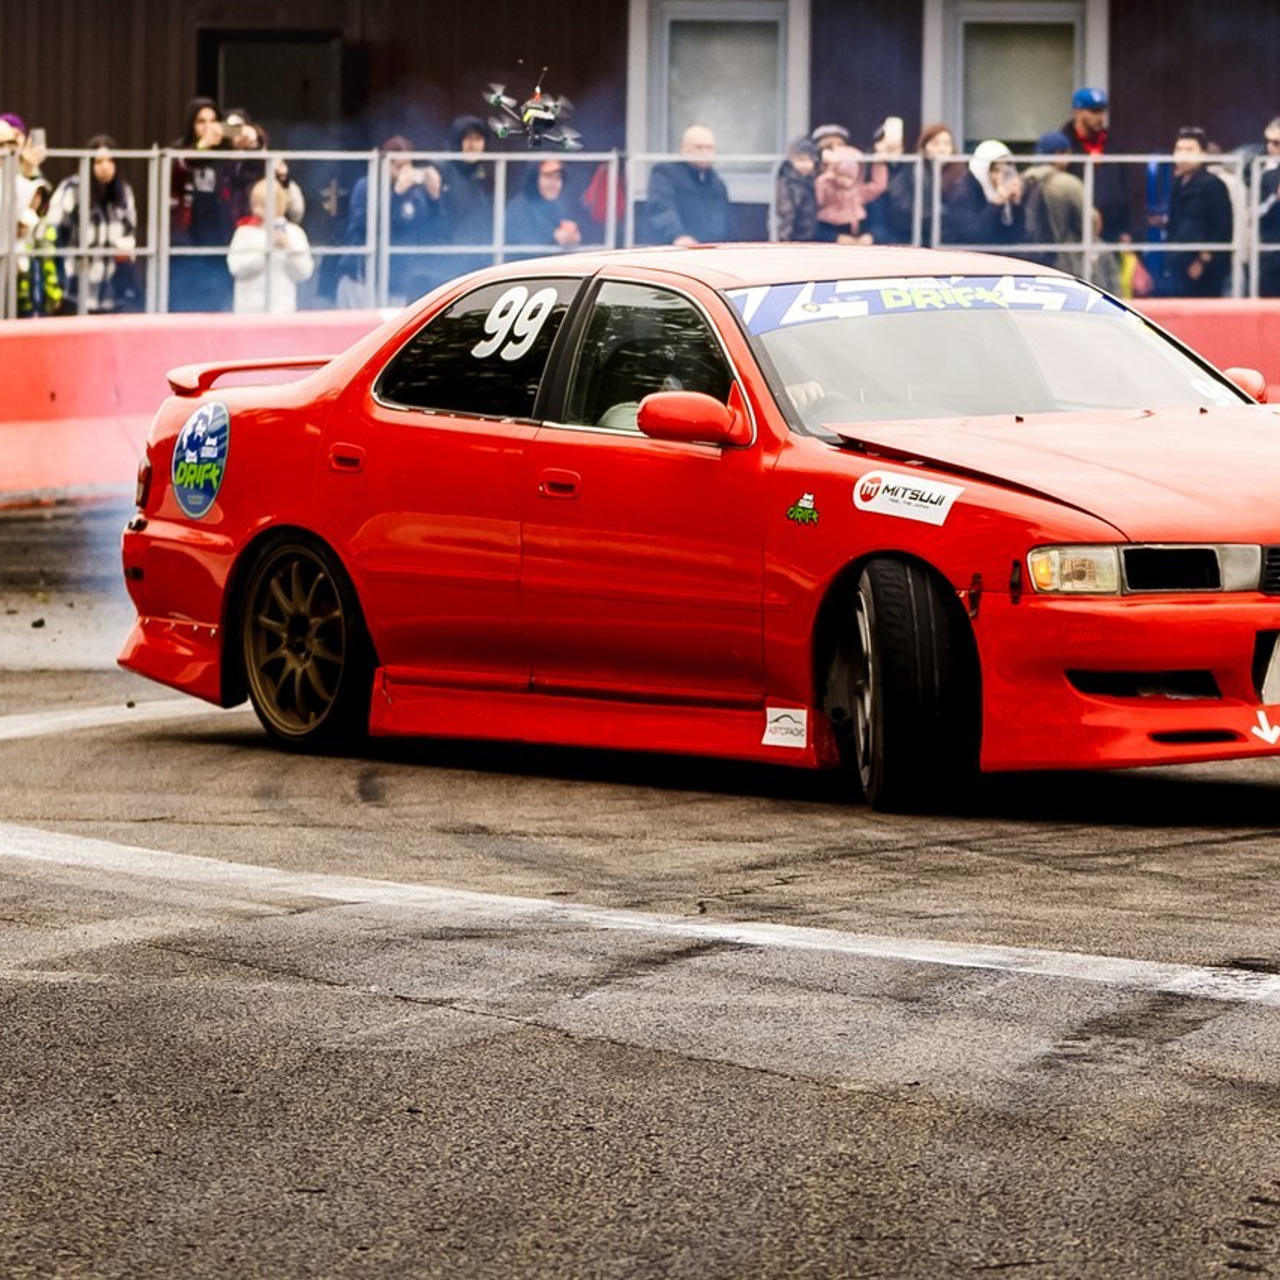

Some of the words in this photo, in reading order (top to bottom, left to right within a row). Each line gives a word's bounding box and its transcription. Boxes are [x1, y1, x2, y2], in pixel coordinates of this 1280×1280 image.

[881, 286, 1010, 310] DRIFT
[470, 285, 558, 360] 99
[882, 485, 946, 506] MITSUJI
